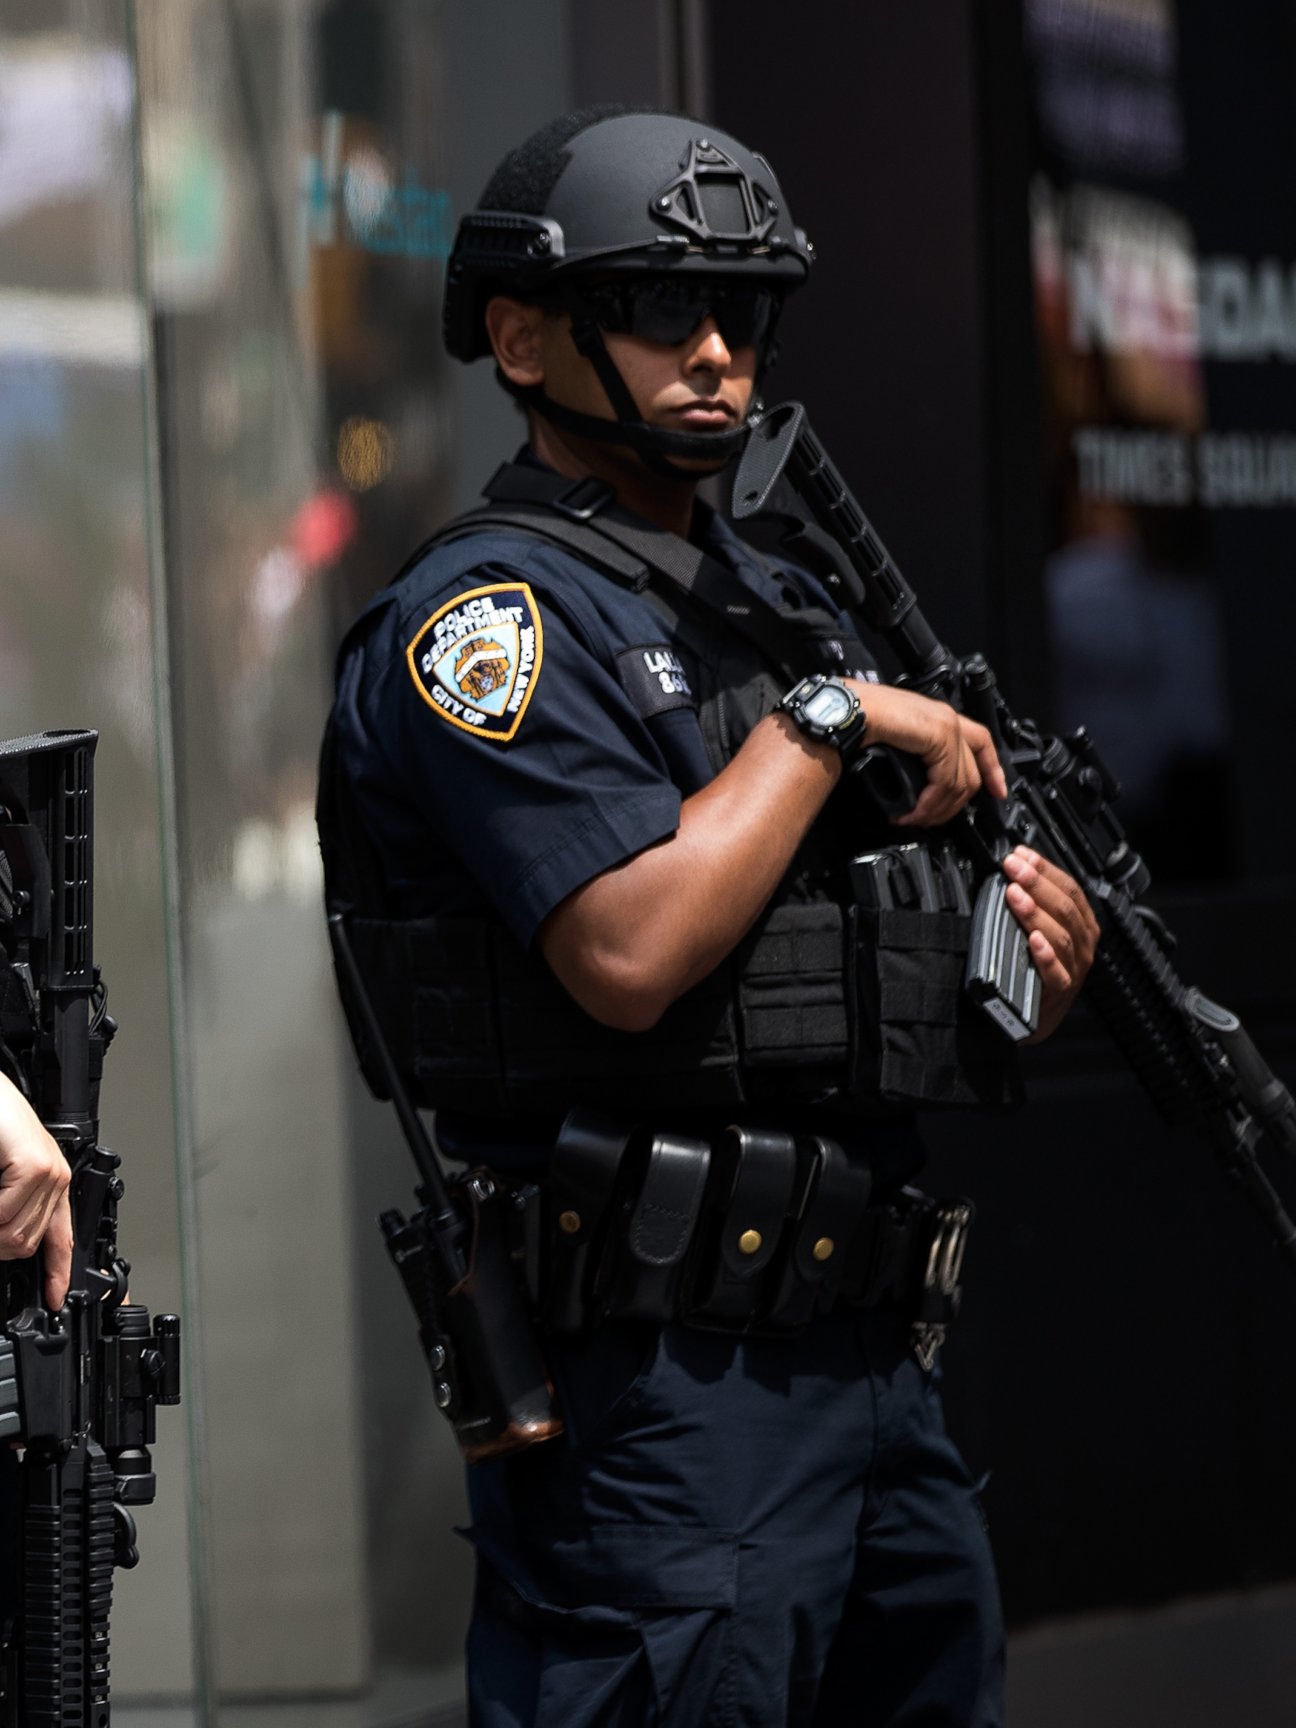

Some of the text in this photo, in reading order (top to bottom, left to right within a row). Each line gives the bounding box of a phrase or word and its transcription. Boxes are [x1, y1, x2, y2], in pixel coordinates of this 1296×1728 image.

[421, 606, 523, 675] DEPARTMENT
[434, 597, 495, 641] POLICE
[507, 625, 535, 713] NEW YORK
[431, 684, 488, 726] CITY OF
